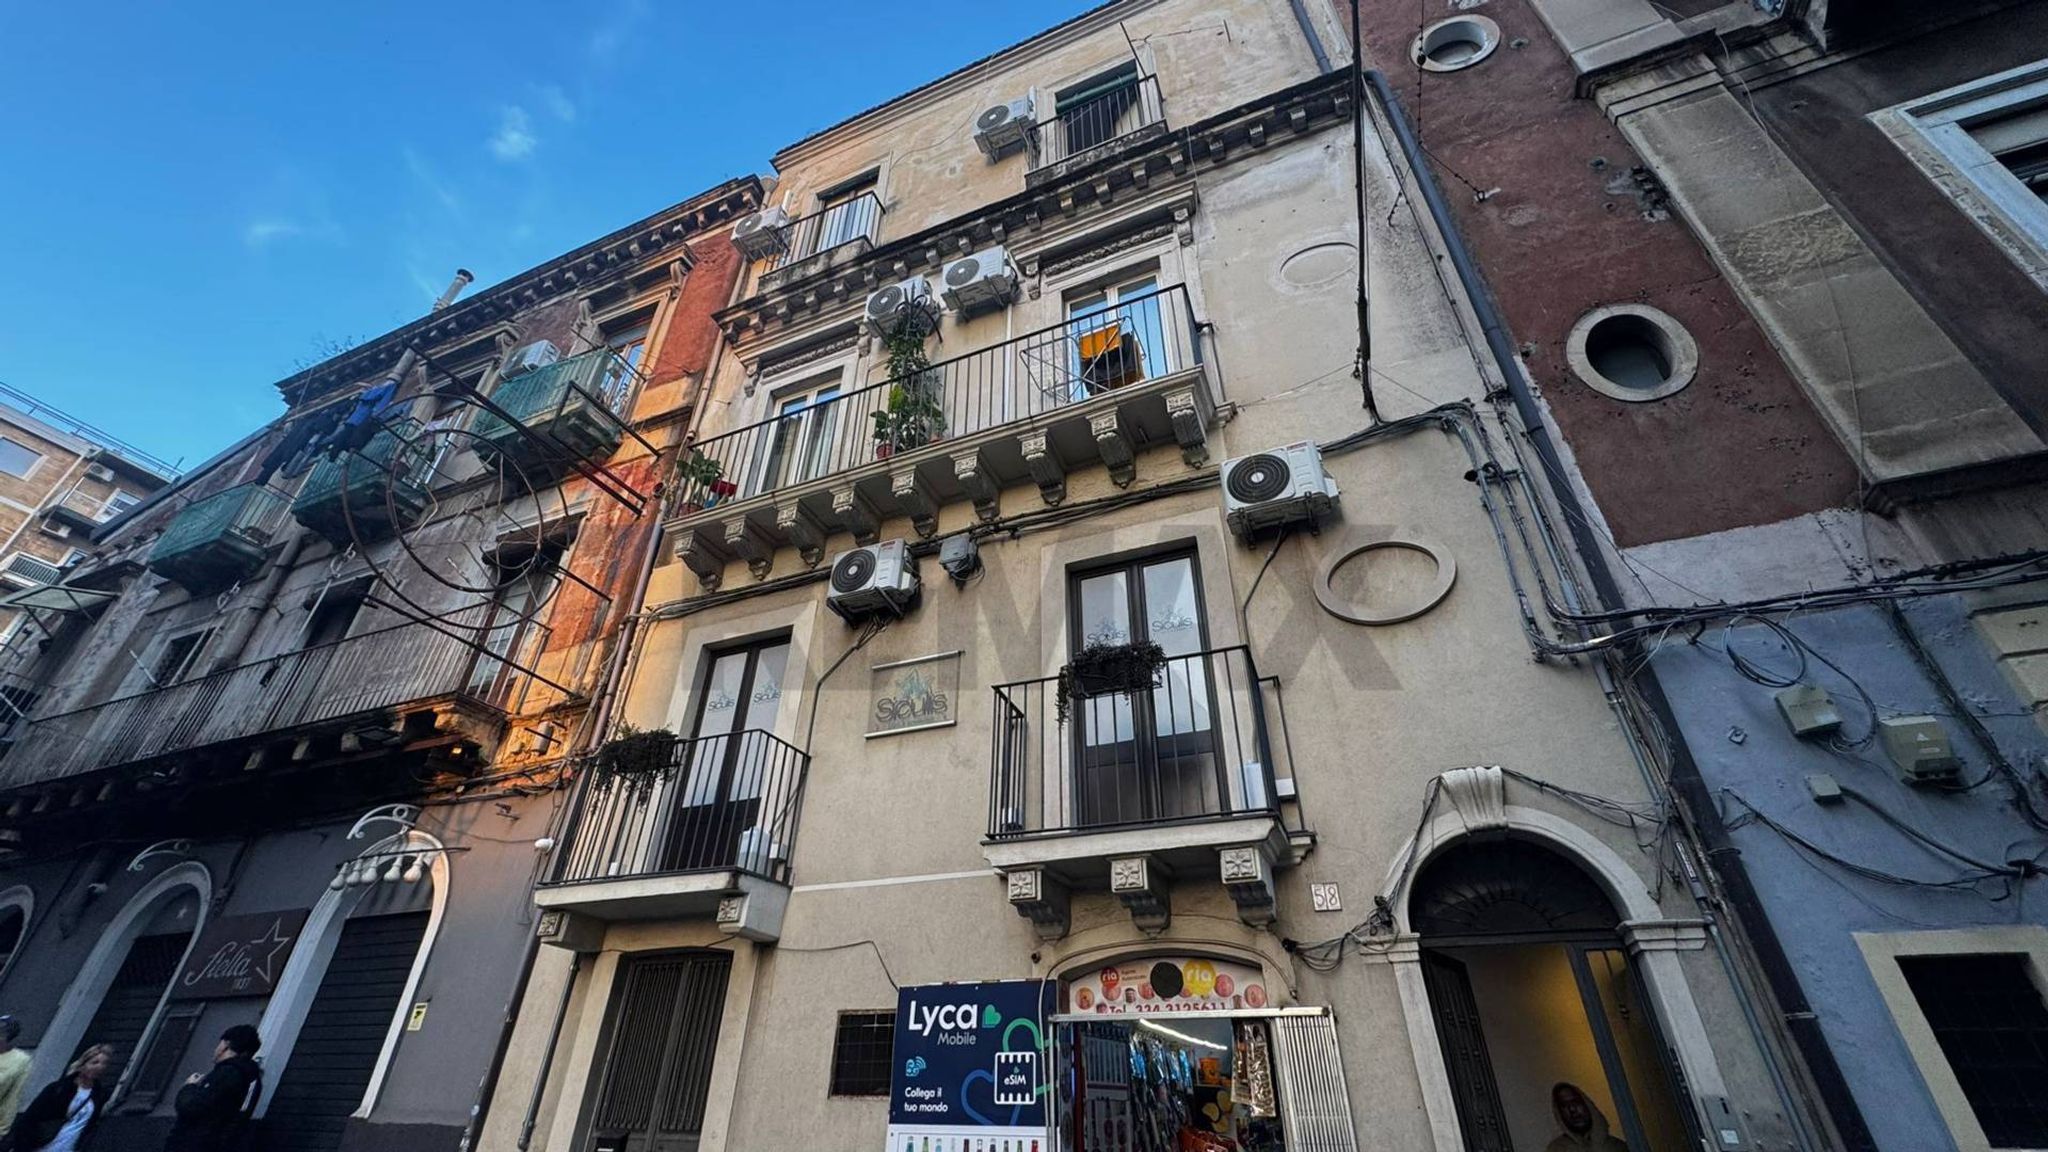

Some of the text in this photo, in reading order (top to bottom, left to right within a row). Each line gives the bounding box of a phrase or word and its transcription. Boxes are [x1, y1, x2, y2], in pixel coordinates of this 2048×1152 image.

[1314, 886, 1338, 907] 58
[184, 940, 252, 986] Stella
[1102, 969, 1118, 981] ria
[1186, 968, 1212, 982] ria
[908, 1000, 978, 1036] Lyca
[937, 1032, 977, 1046] Mobile
[904, 1086, 943, 1100] Collega il
[904, 1102, 949, 1112] tuo mondo
